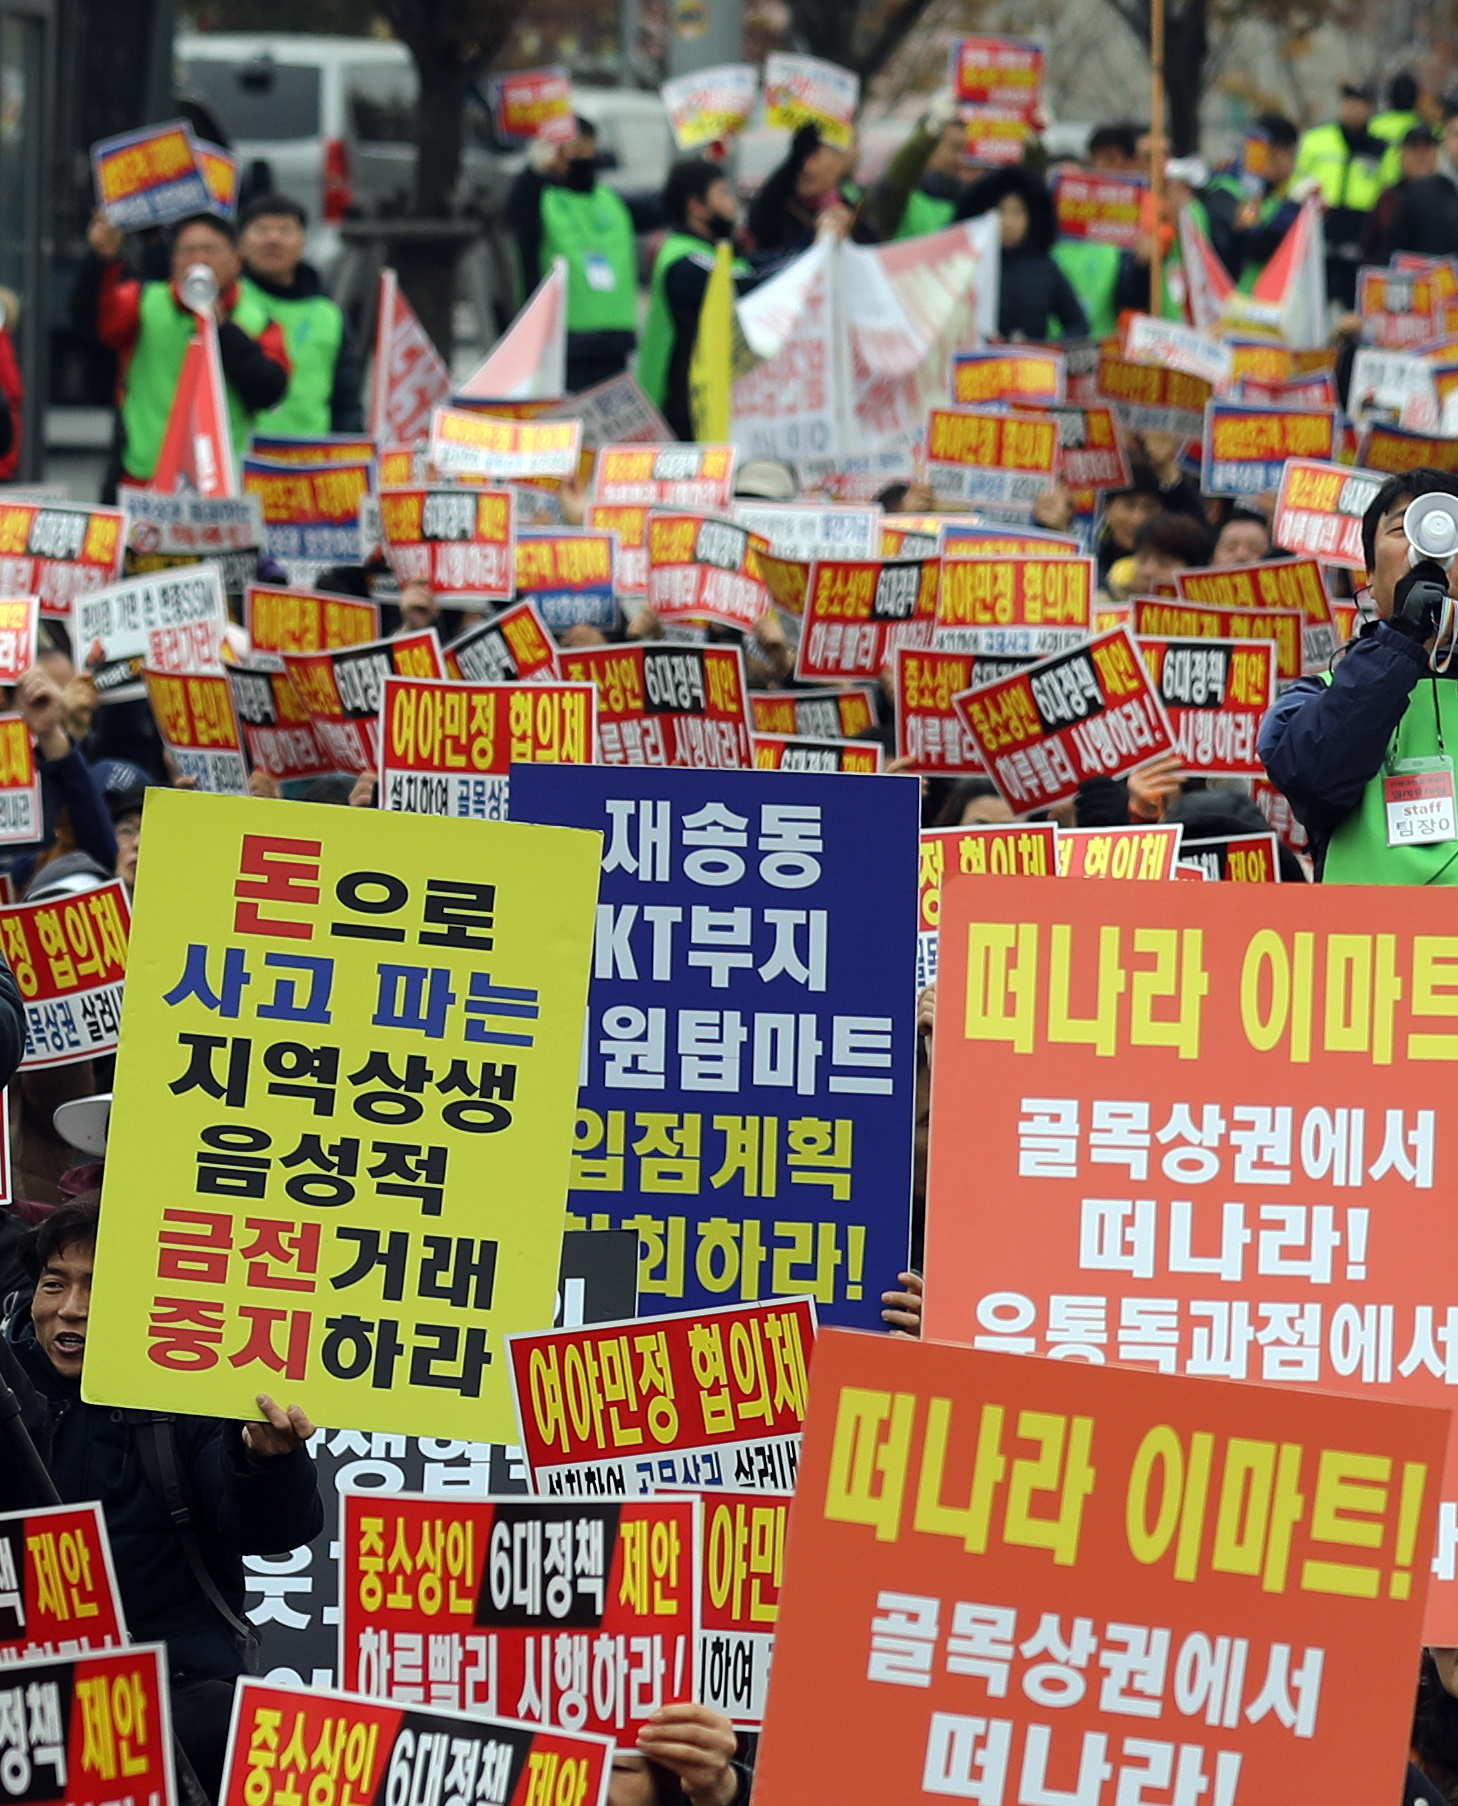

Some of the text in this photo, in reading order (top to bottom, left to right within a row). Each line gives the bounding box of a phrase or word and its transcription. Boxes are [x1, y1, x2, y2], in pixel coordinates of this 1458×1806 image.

[645, 651, 704, 711] 6대정책
[971, 641, 1140, 755] 중소상인 6대정책 제안
[1162, 648, 1266, 705] 6대정책 제안
[391, 694, 587, 763] 여야민정 협의체
[995, 705, 1164, 805] 하루빨리 시행하라!
[601, 799, 824, 889] 재송동
[1402, 800, 1444, 818] staff
[233, 834, 498, 952] 돈으로
[163, 943, 540, 1047] 사고 파는
[597, 908, 828, 991] KT부지
[964, 921, 1209, 1061] 떠나라
[169, 1033, 517, 1135] 지역상생
[580, 1004, 894, 1096] 원탑마트
[195, 1124, 450, 1215] 음성적
[571, 1110, 854, 1201] 입점계획
[1016, 1096, 1436, 1189] 골목상권에서
[157, 1208, 498, 1311] 금전거래
[1078, 1199, 1369, 1283] 떠나라!
[146, 1296, 492, 1398] 중지하라
[529, 1331, 680, 1454] 여야민정
[823, 1385, 1428, 1600] 떠나라 이마트!
[357, 1509, 680, 1619] 중소상인 6대정책 제안
[867, 1589, 1326, 1739] 골목상권에서
